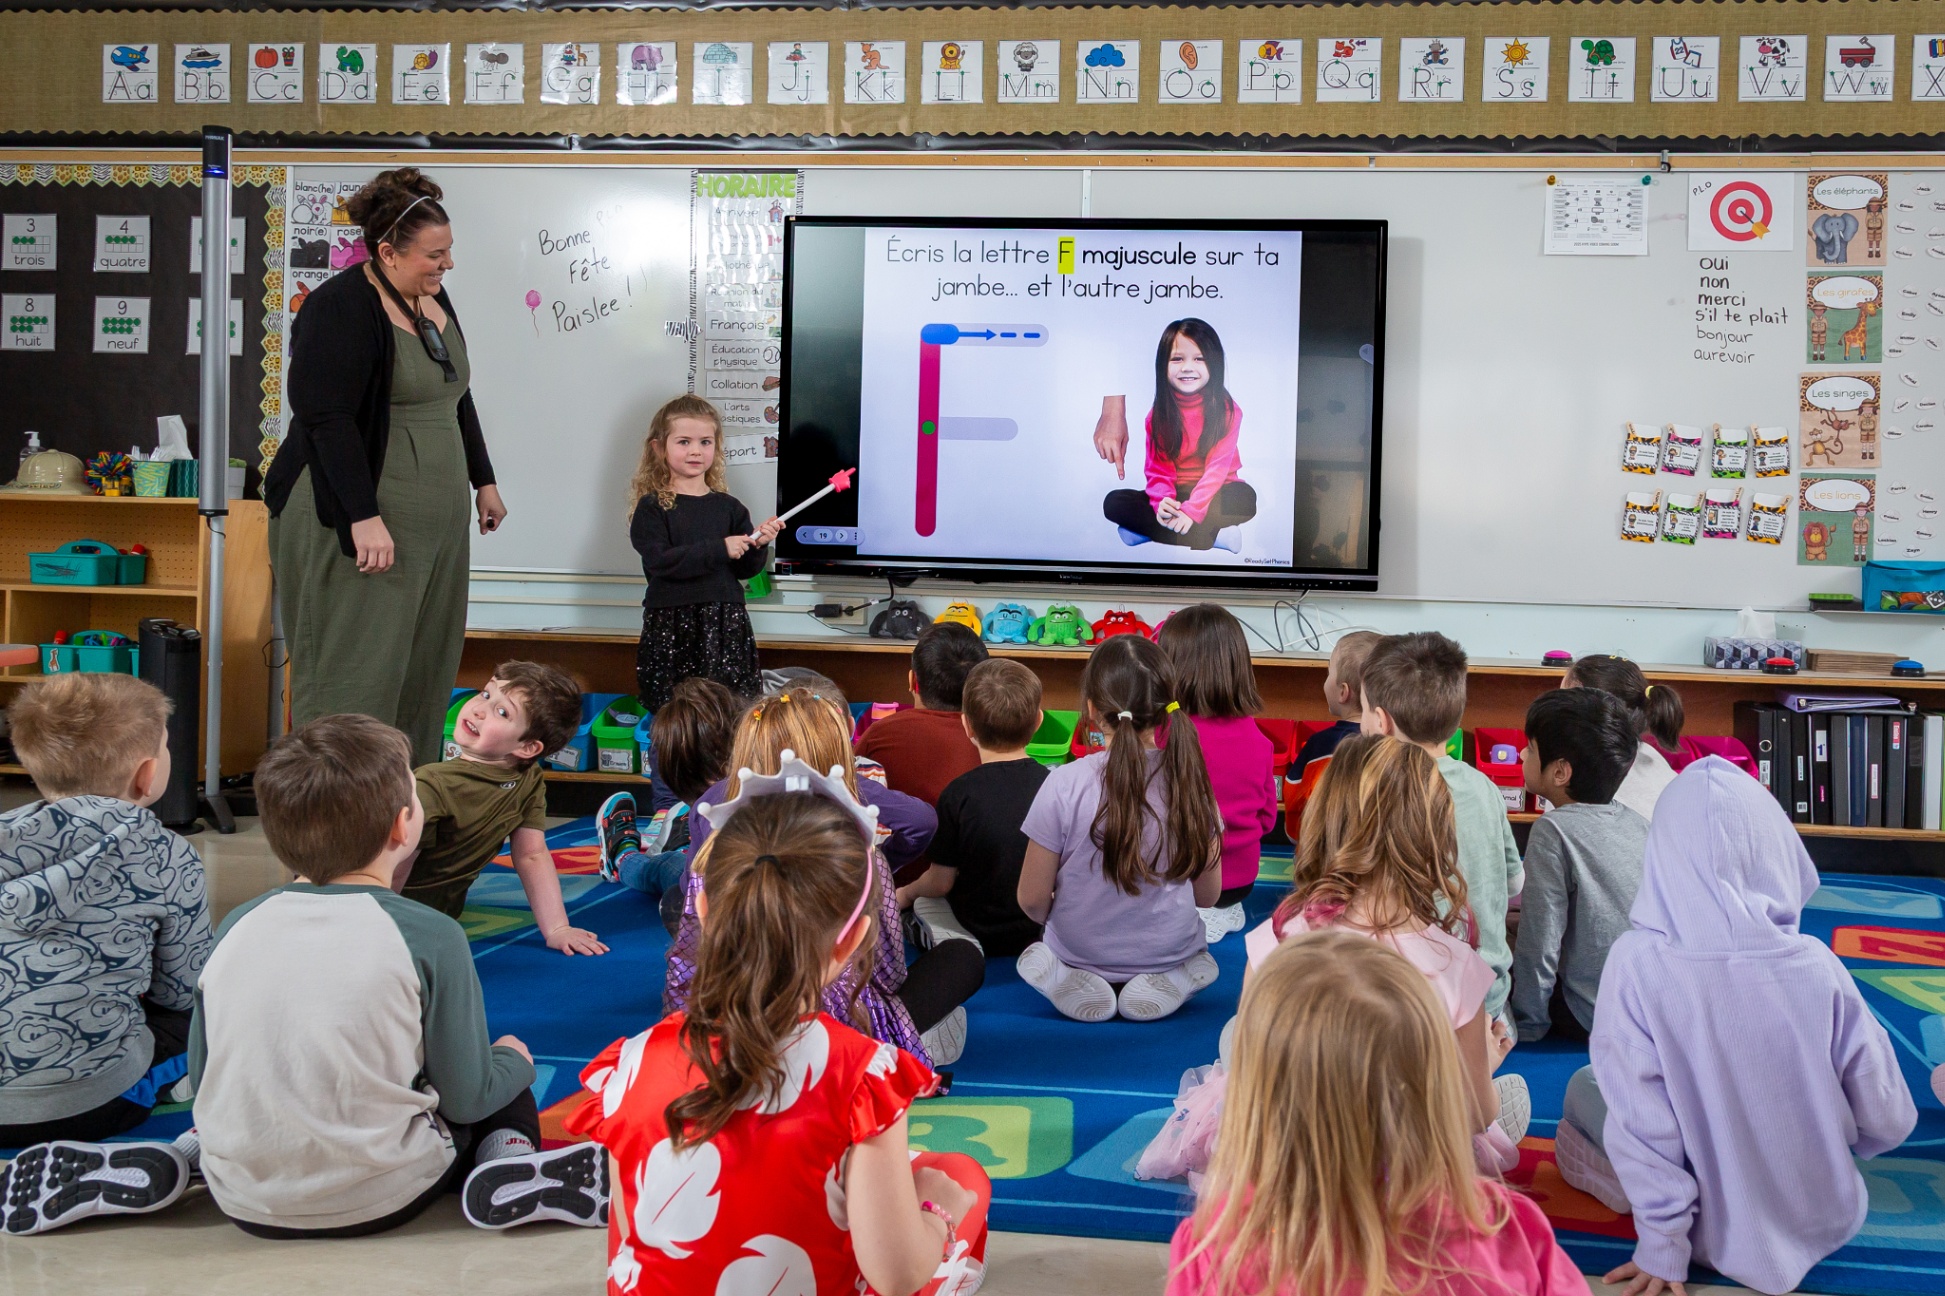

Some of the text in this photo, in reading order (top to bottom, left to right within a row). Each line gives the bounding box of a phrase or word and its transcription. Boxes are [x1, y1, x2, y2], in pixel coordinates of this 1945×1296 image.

[1674, 46, 1684, 55] 22
[295, 182, 334, 194] blanc(he)
[696, 173, 796, 199] HORAIRE
[1816, 186, 1879, 197] Les éléphants
[26, 218, 36, 233] 3
[119, 220, 129, 234] 4
[293, 226, 328, 237] noir(e)
[538, 229, 591, 256] Bonne
[887, 234, 1279, 271] Écris la lettre F majuscule sur ta
[14, 255, 45, 266] trois
[99, 257, 147, 270] quatre
[569, 246, 611, 284] Fête
[292, 271, 329, 282] orange
[1699, 276, 1730, 290] non
[931, 273, 1223, 304] jambe... et l'autre jambe.
[1817, 287, 1875, 298] Les girafes
[24, 297, 35, 313] 8
[1697, 290, 1746, 307] merci
[117, 300, 128, 315] 9
[1695, 307, 1718, 322] s'il
[1724, 308, 1743, 322] te
[710, 319, 764, 333] Français
[15, 334, 42, 347] huit
[107, 337, 140, 349] neuf
[1696, 324, 1753, 349] bonjour
[711, 343, 760, 355] Éducation
[713, 356, 758, 368] physique
[1693, 348, 1755, 364] aurevoir
[710, 379, 759, 390] Collation
[1811, 388, 1870, 400] Les singes
[724, 402, 751, 412] L'arts
[720, 413, 761, 425] astiques
[724, 446, 757, 460] épart
[1813, 490, 1861, 501] Les lions
[819, 532, 828, 540] 19
